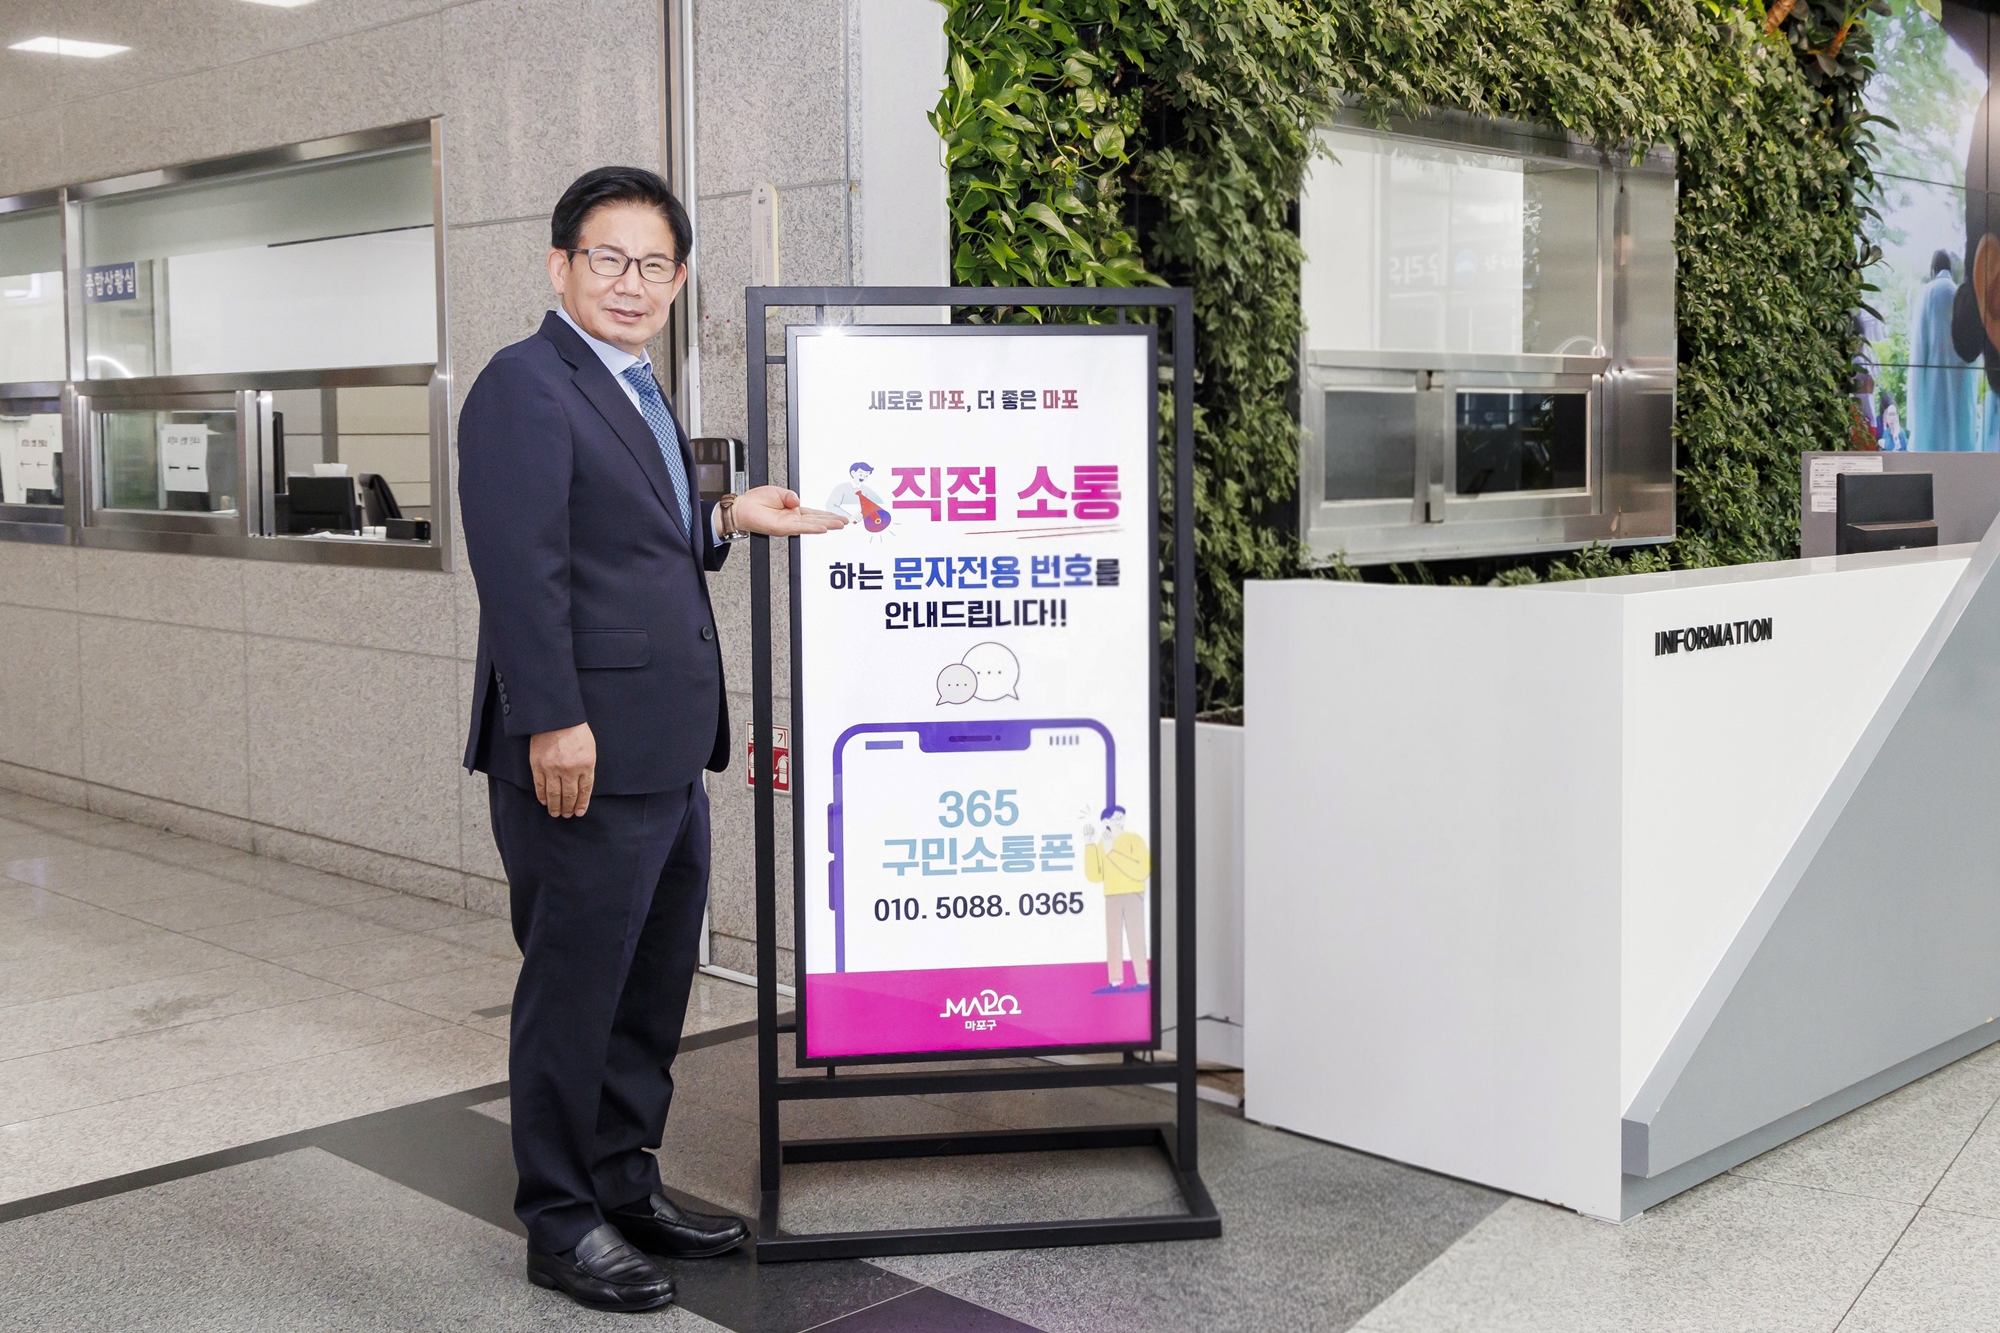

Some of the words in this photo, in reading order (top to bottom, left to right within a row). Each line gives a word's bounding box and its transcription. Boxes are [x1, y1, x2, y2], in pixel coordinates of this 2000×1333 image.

[85, 268, 134, 297] 종합상황실
[869, 391, 923, 410] 새로운
[930, 391, 971, 412] 마포,
[978, 390, 994, 409] 더
[1002, 390, 1036, 410] 좋은
[1043, 390, 1078, 409] 마포
[891, 467, 996, 522] 직접
[1017, 465, 1121, 520] 소통
[829, 562, 883, 590] 하는
[893, 556, 1020, 590] 문자전용
[1032, 554, 1120, 588] 번호를
[885, 599, 1066, 629] 안내드립니다!!
[1655, 618, 1772, 656] INFORMATION
[939, 790, 1018, 827] 365
[883, 835, 1074, 875] 구민소통폰
[1019, 892, 1084, 916] 0365
[965, 1020, 996, 1031] 마포구
